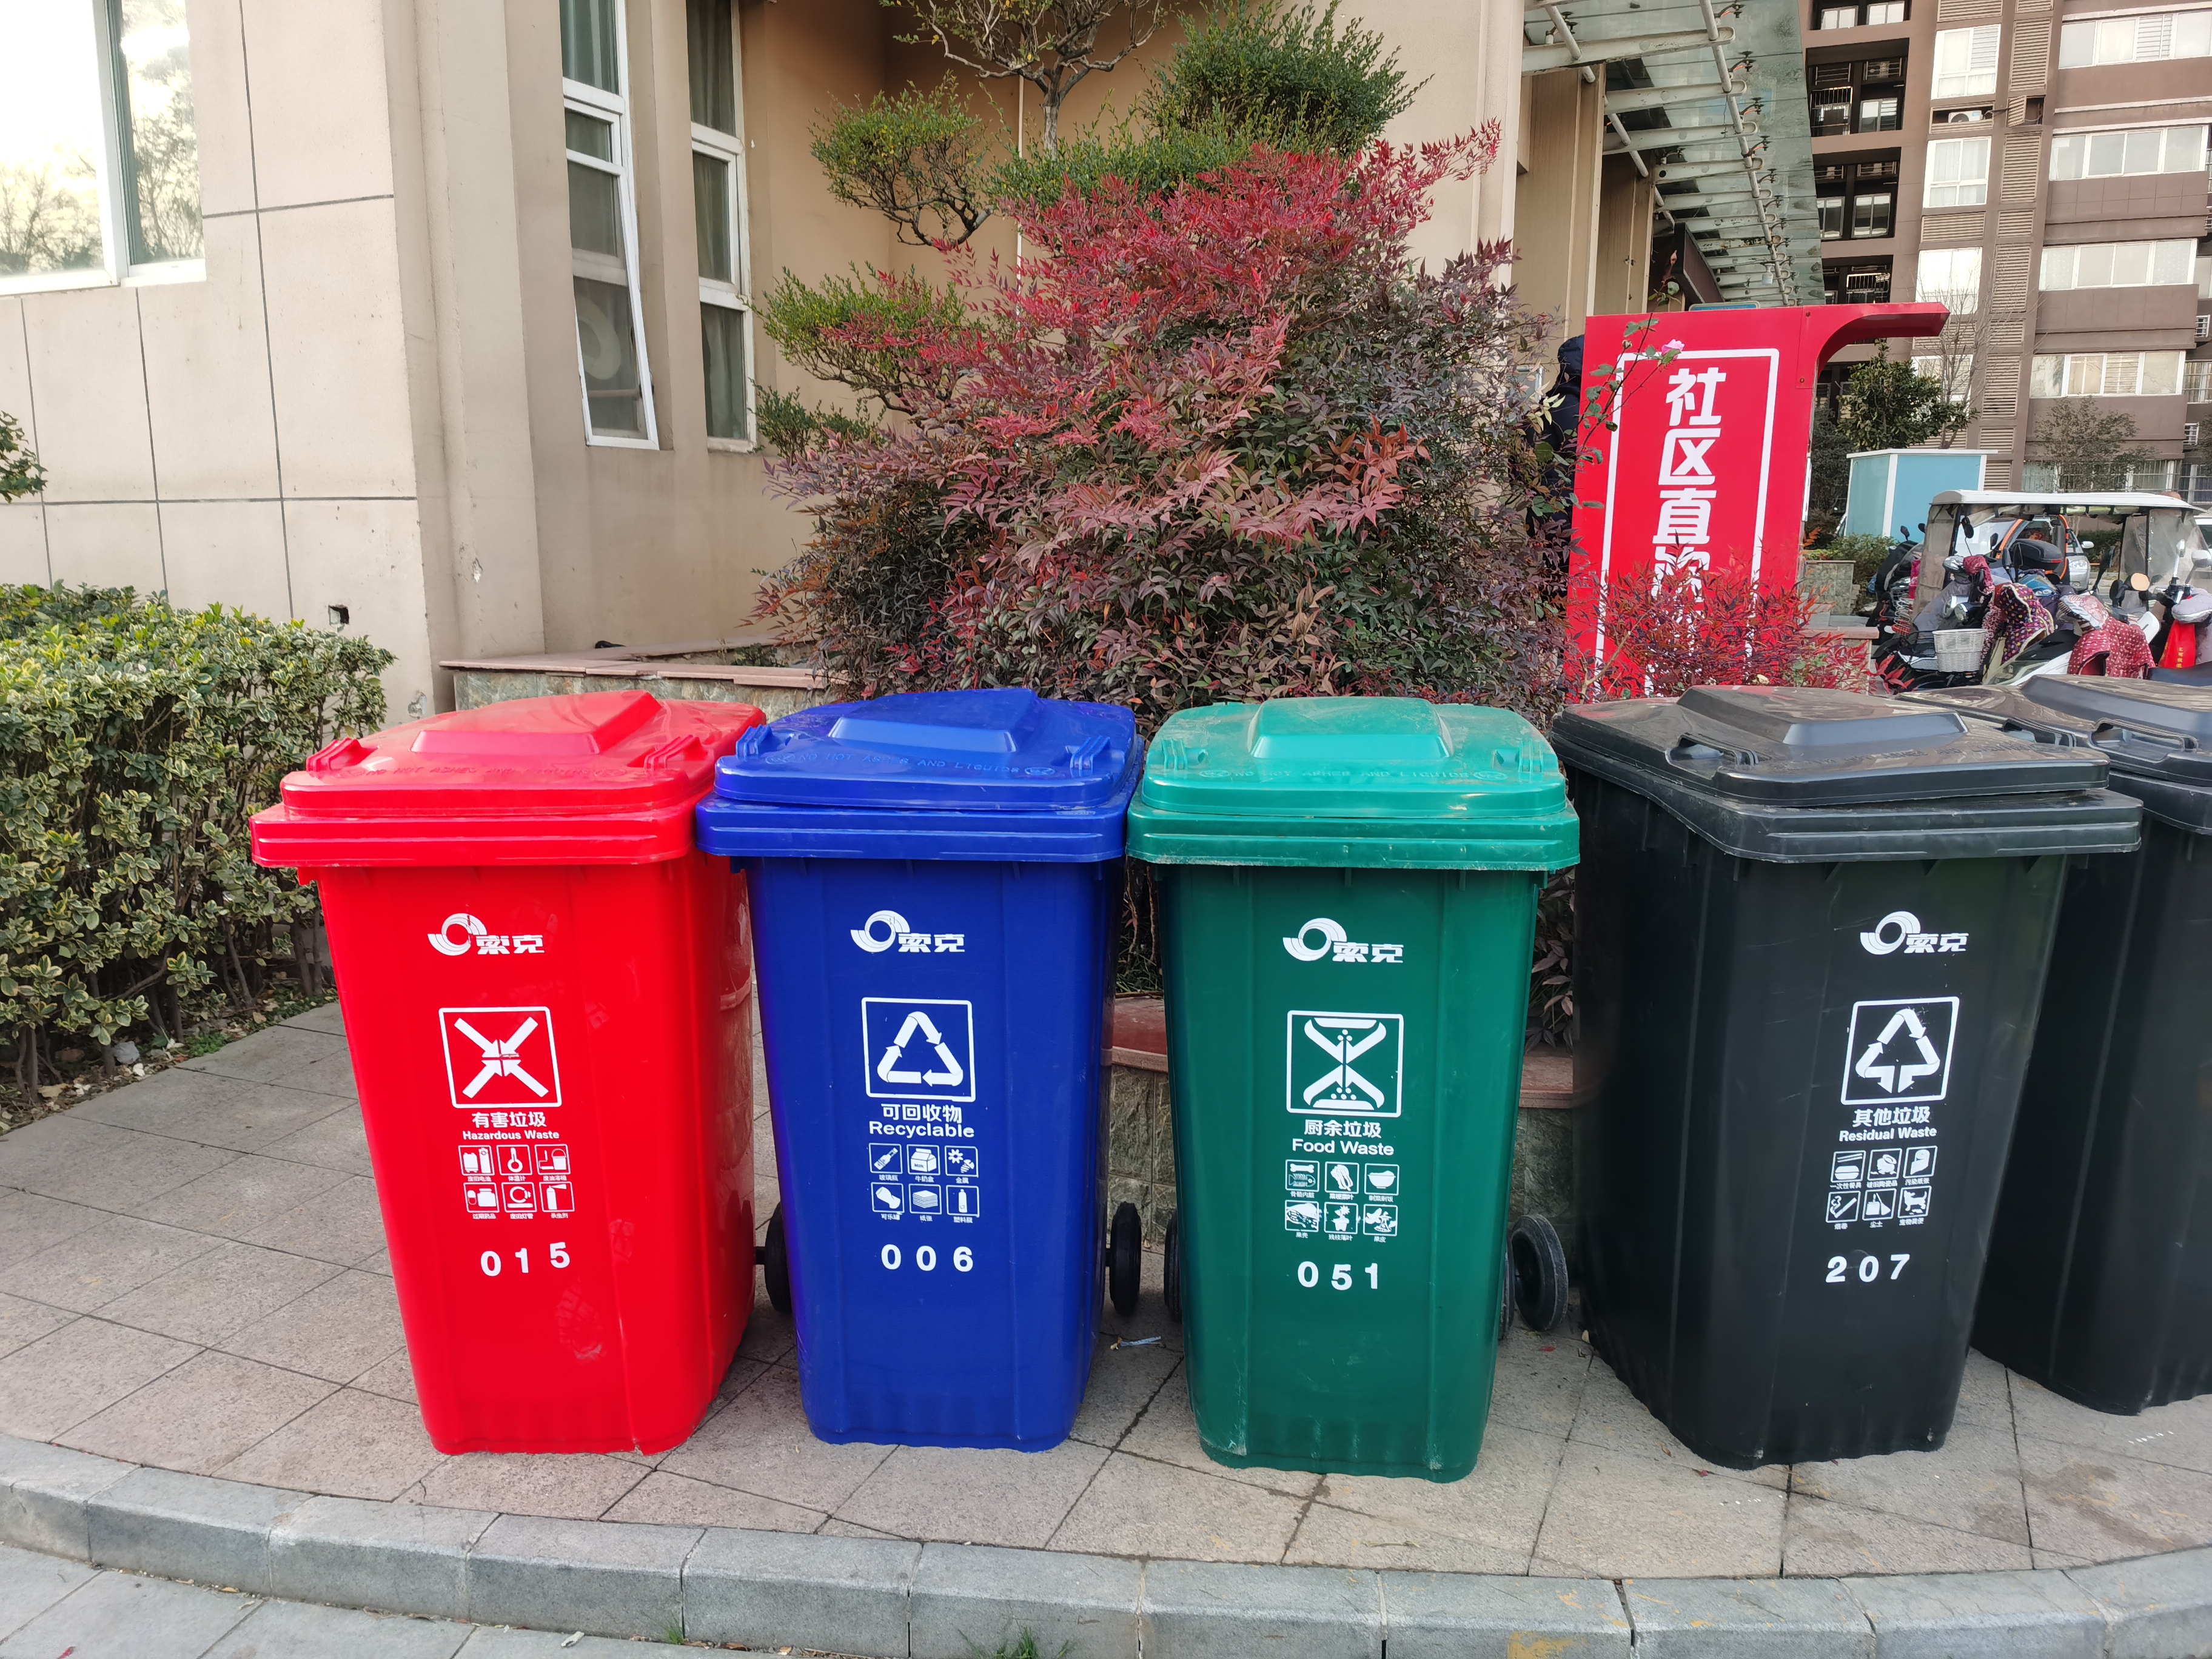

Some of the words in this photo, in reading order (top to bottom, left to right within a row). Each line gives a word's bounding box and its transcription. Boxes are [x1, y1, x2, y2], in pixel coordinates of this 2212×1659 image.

[917, 759, 946, 768] AND
[898, 933, 965, 953] 索克
[1903, 933, 1969, 954] 索克
[1332, 942, 1404, 964] 索克
[472, 1111, 547, 1128] 有害垃圾
[880, 1104, 962, 1124] 可回收物
[1852, 1106, 1931, 1127] 其他垃圾
[462, 1130, 521, 1140] Hazardous
[524, 1130, 560, 1139] Waste
[869, 1121, 975, 1139] Recyclable
[1304, 1119, 1382, 1139] 厨余垃圾
[1839, 1127, 1895, 1142] Residual
[1897, 1126, 1937, 1139] Waste
[1292, 1138, 1335, 1153] Food
[1339, 1140, 1395, 1156] Waste
[1829, 1181, 1862, 1190] 一次性餐具
